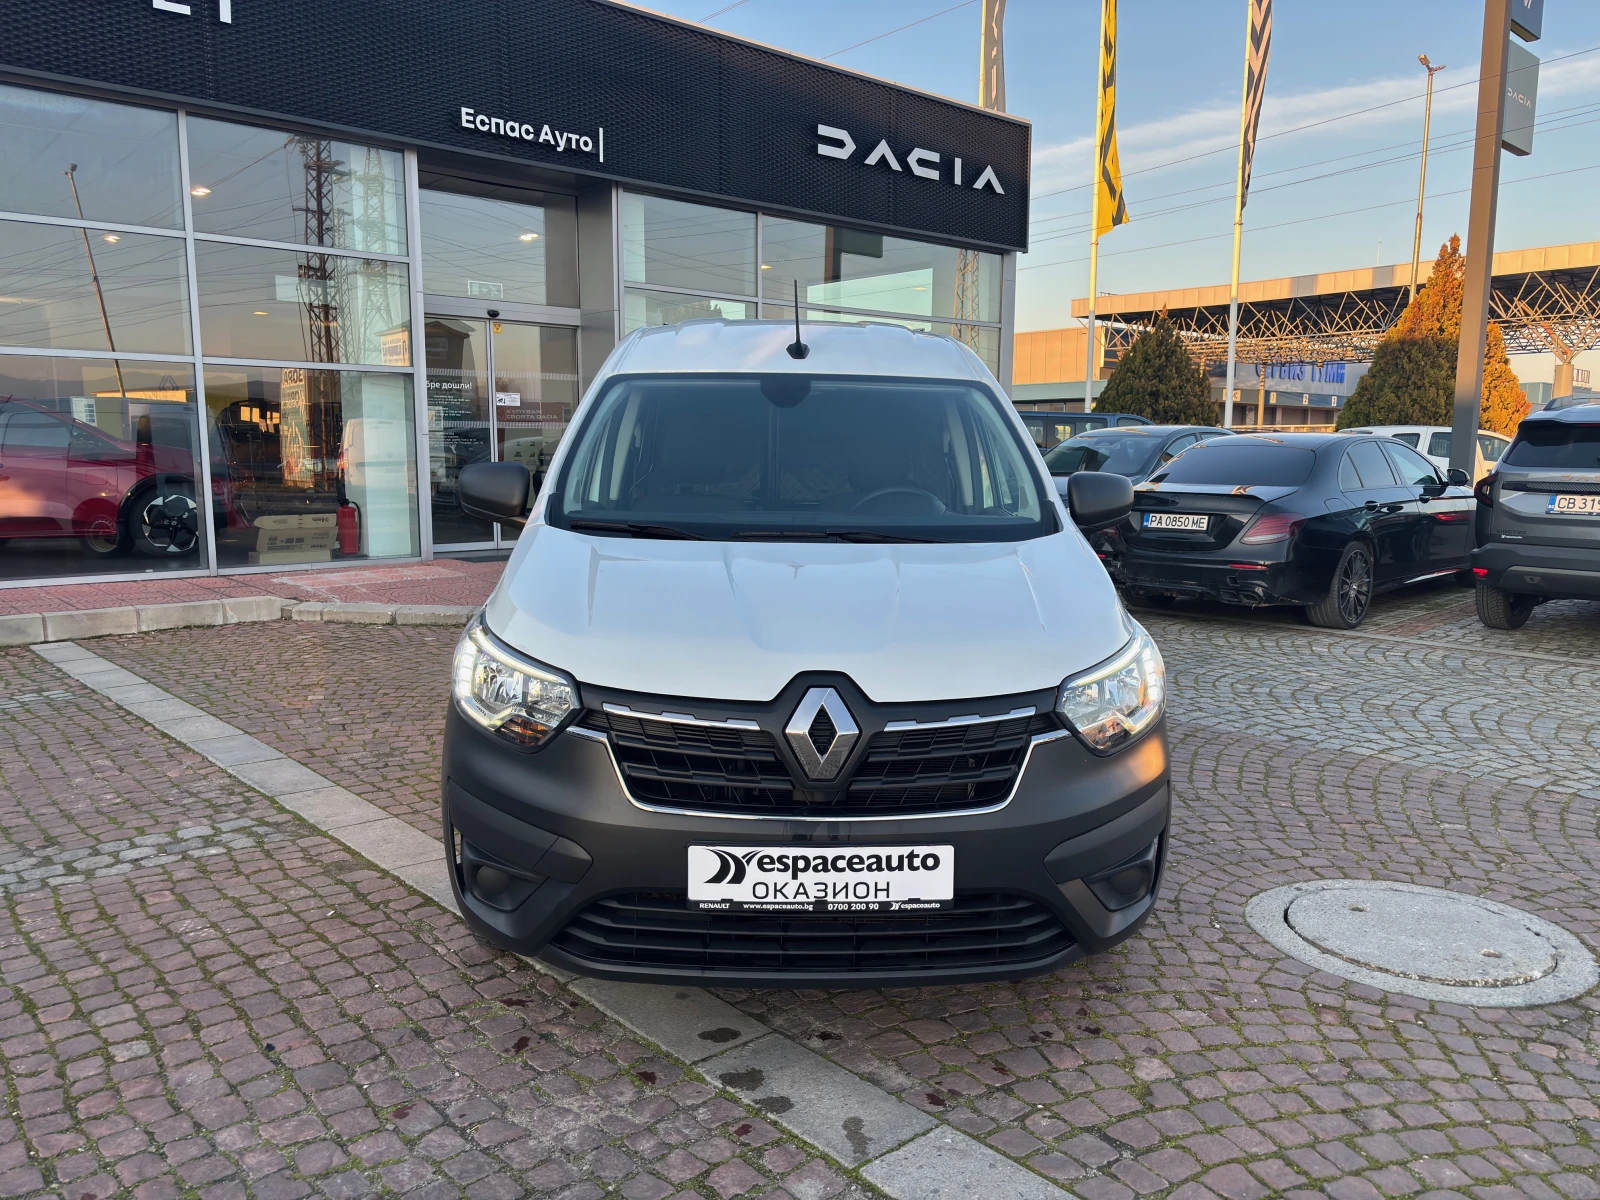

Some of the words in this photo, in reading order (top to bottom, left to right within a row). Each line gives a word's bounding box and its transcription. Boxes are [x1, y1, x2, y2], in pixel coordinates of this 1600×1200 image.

[1507, 87, 1531, 108] DACIA
[461, 107, 535, 141] Еспас
[538, 124, 593, 152] Ауто
[818, 124, 1005, 195] DACIA
[442, 382, 472, 390] дошли!
[1150, 516, 1162, 526] PA
[1165, 516, 1190, 528] 0850
[1191, 517, 1206, 528] ME
[756, 848, 940, 880] espaceauto
[752, 881, 890, 900] ОКАЗИОН
[743, 903, 814, 911] www.espaceauto.bg
[900, 902, 940, 910] espaceauto
